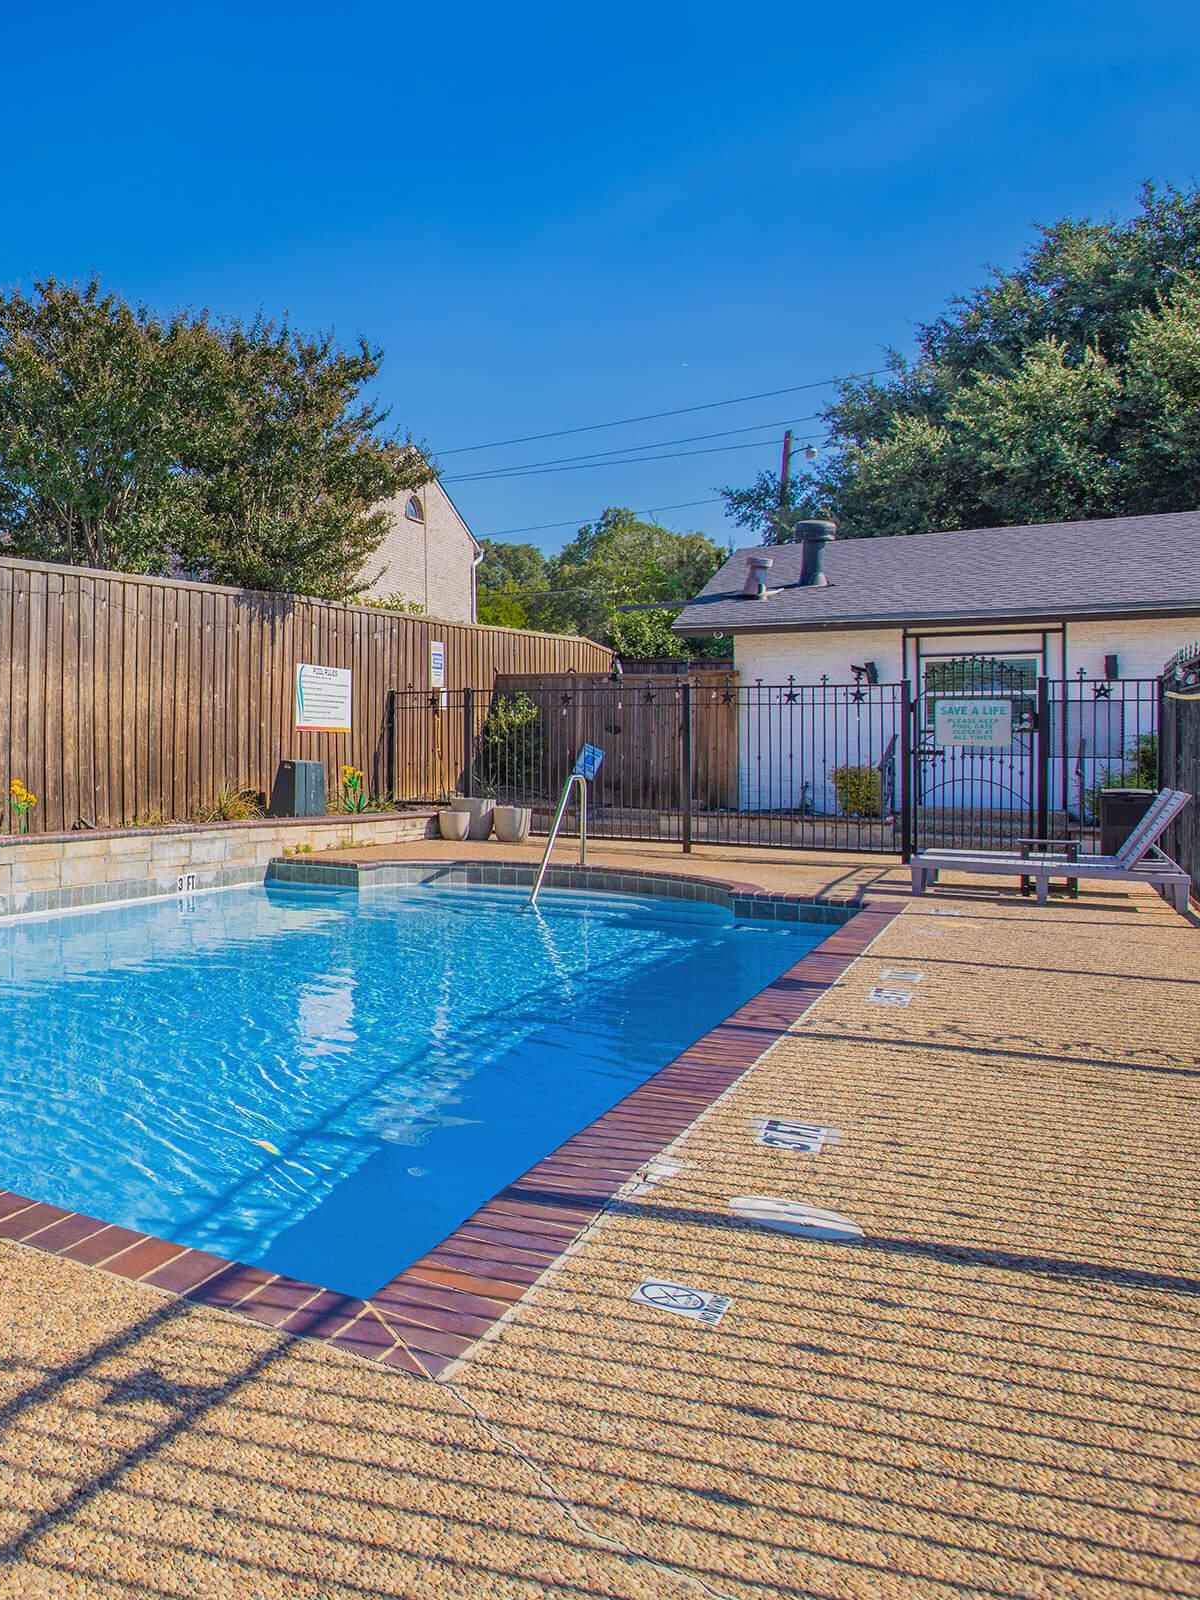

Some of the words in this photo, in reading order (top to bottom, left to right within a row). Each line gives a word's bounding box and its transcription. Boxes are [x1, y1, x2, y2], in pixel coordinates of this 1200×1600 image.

[940, 706, 968, 715] SAVE
[971, 706, 979, 715] A
[983, 706, 1007, 715] LIFE
[178, 877, 184, 891] 3
[187, 875, 196, 890] FT
[765, 1120, 821, 1139] FT
[762, 1136, 811, 1151] 3
